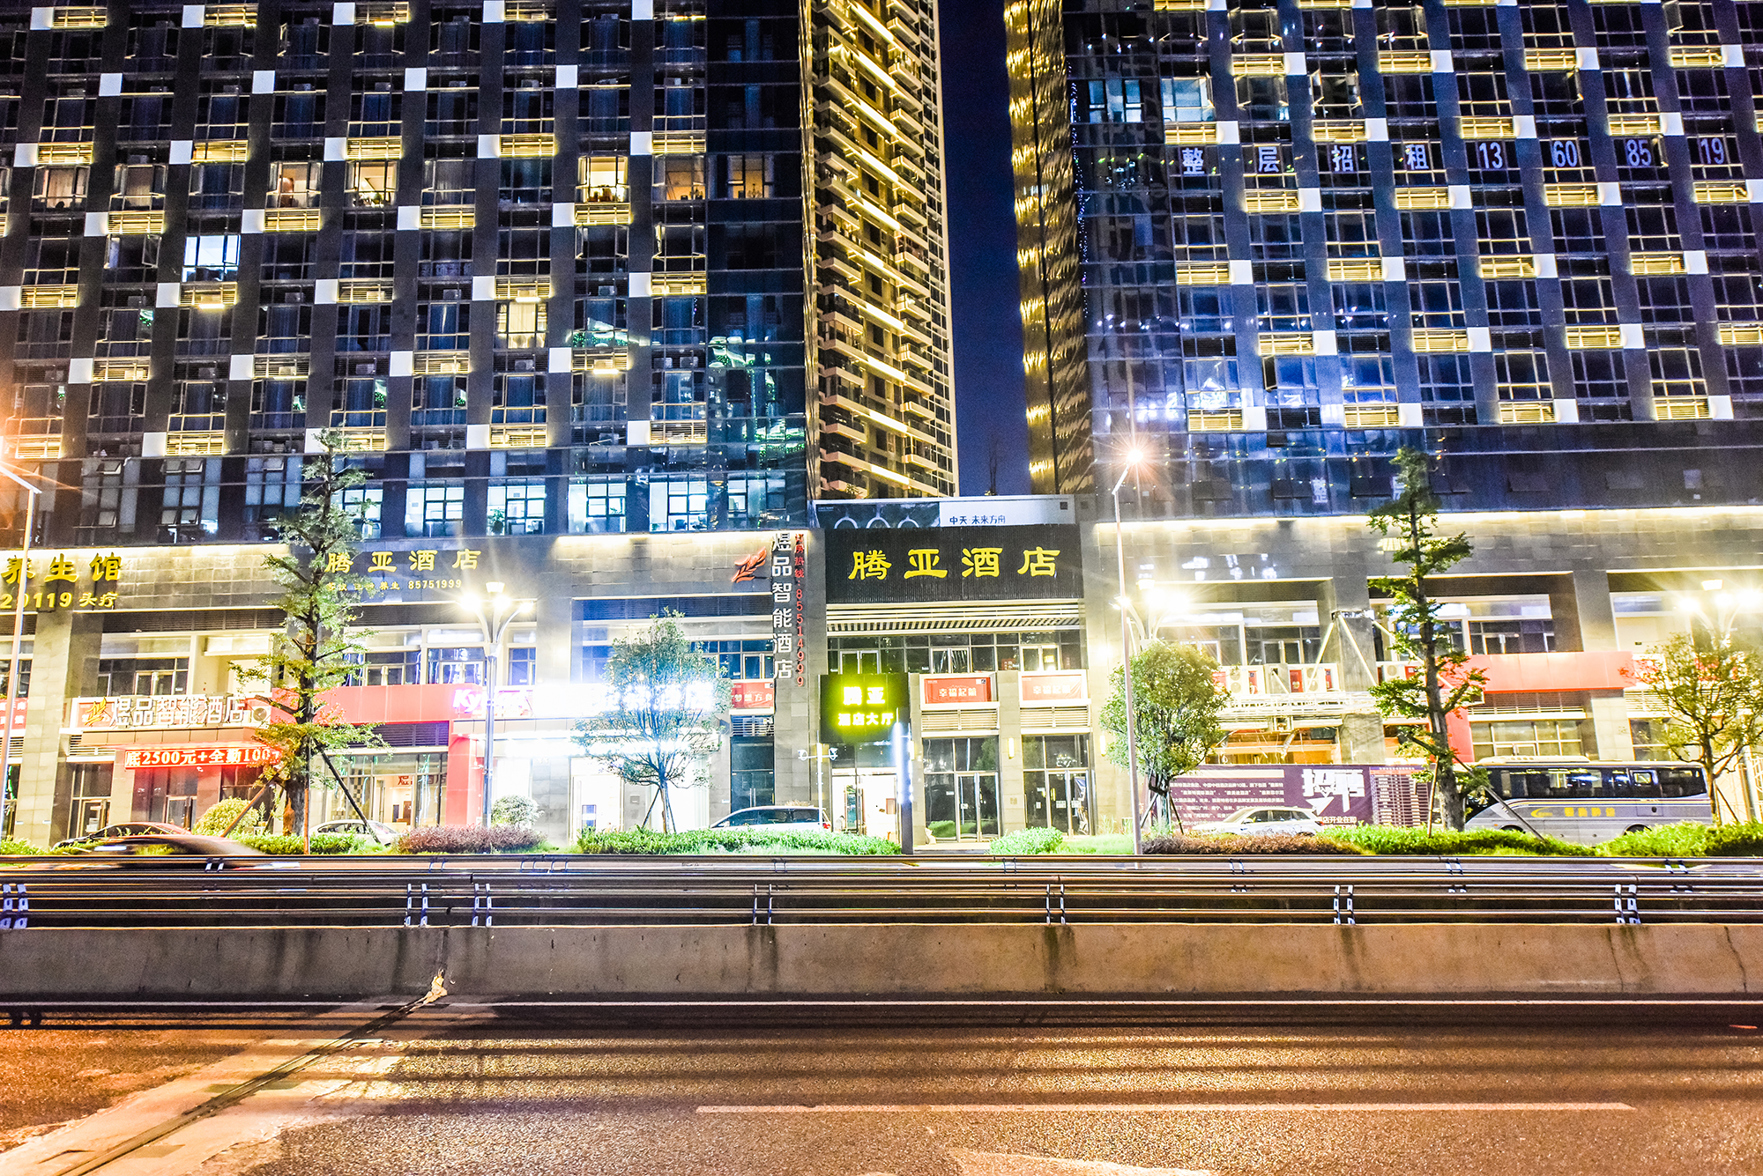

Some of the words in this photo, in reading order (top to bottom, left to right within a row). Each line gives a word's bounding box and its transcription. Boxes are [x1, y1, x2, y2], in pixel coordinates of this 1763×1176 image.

[1182, 144, 1429, 175] 整层招租
[1, 552, 122, 584] 养生馆
[324, 548, 482, 574] 腾亚酒店
[848, 546, 1061, 580] 腾亚酒店
[408, 578, 462, 590] 85751999
[79, 591, 119, 607] 头疗
[772, 532, 793, 680] 煜品智能酒店
[838, 712, 894, 726] 酒店大厅
